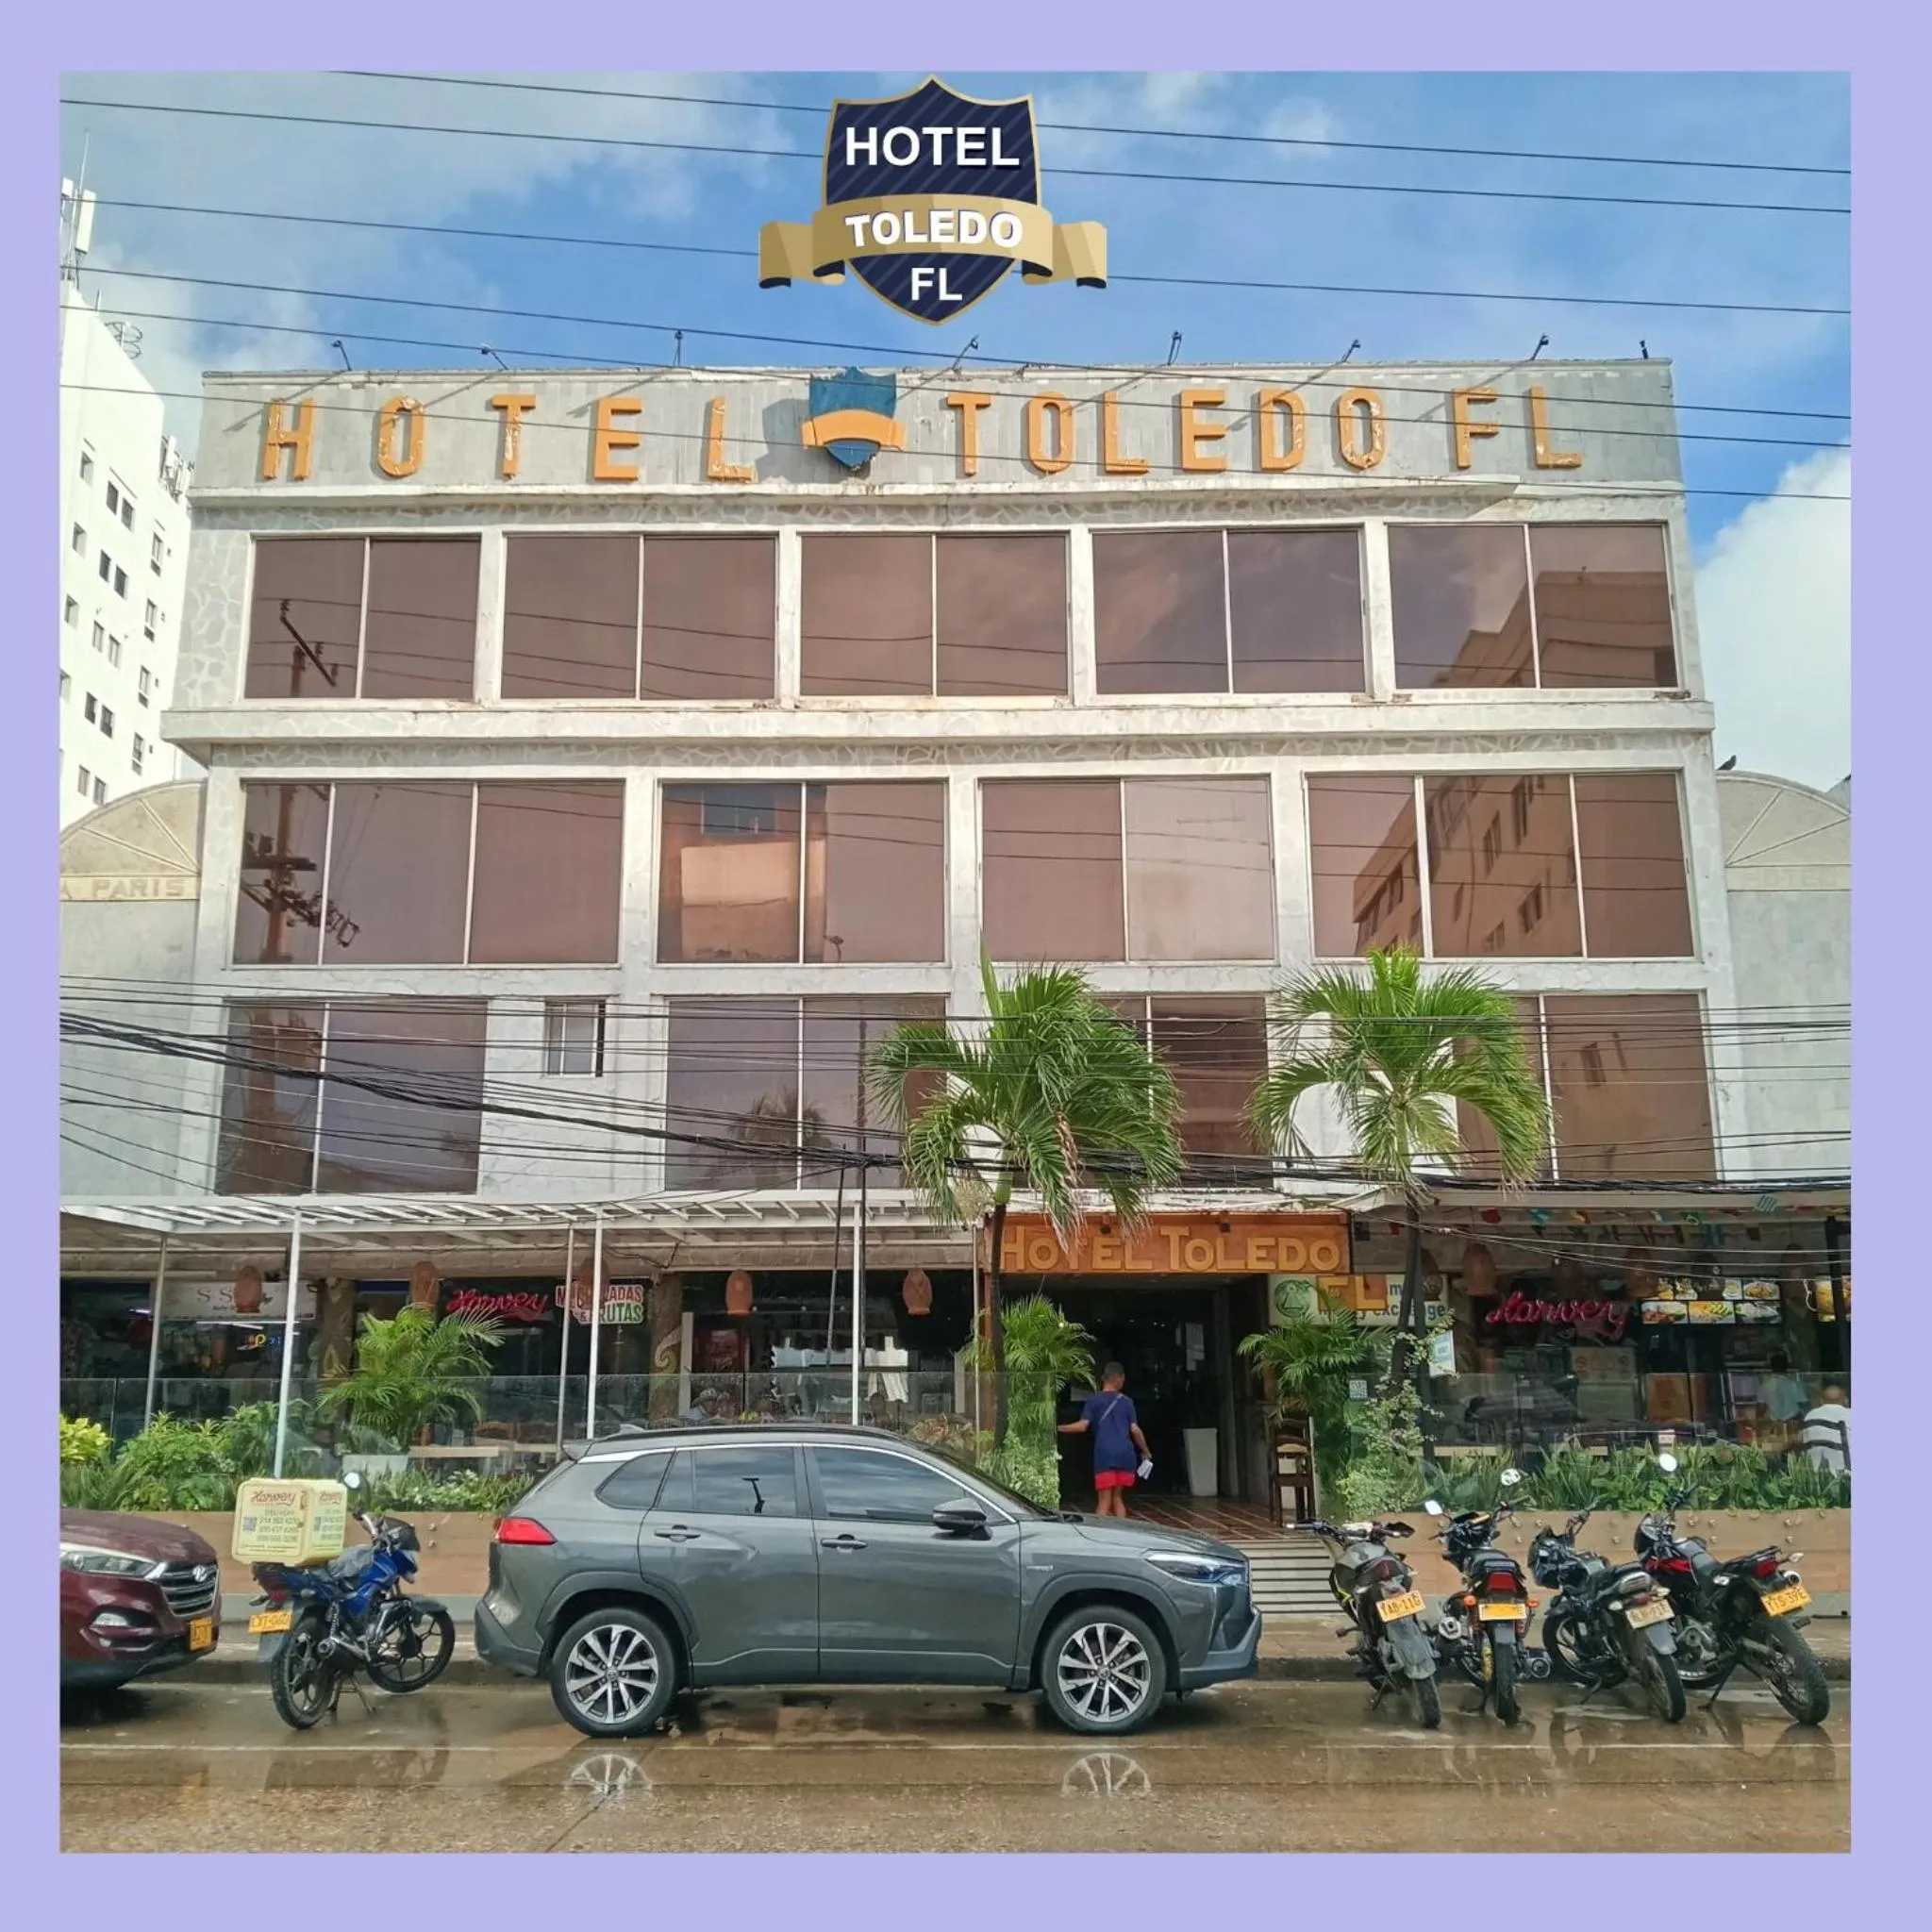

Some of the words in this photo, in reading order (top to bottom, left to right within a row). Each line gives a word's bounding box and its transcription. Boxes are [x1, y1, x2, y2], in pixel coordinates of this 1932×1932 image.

[262, 393, 753, 481] HOTEL
[946, 385, 1389, 476] TOLEDO
[1453, 385, 1583, 469] FL
[92, 877, 185, 898] PARIS
[1159, 1225, 1341, 1272] TOLEDO
[590, 1304, 642, 1322] RUTAS
